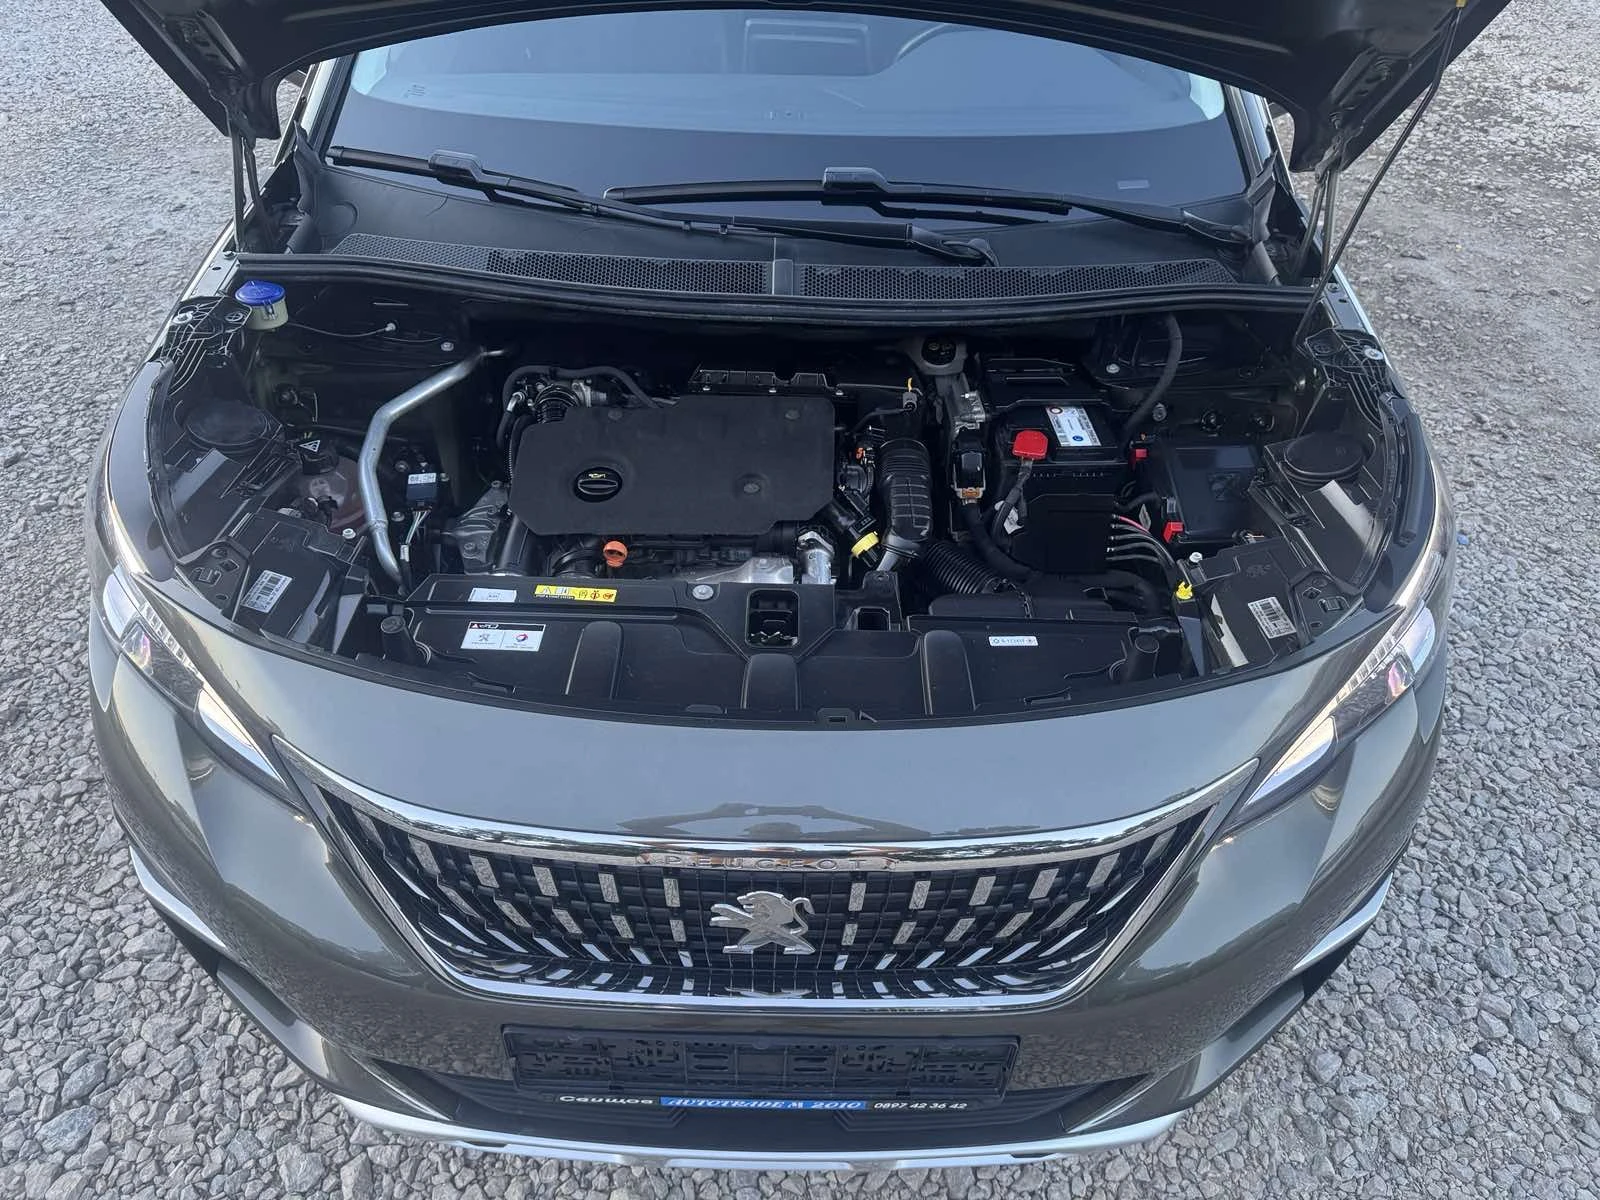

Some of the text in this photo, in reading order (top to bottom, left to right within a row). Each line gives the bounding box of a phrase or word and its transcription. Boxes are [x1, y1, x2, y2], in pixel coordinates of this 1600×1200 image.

[664, 855, 868, 870] PEUGEOT
[668, 1098, 785, 1108] AUTOTRADE
[810, 1101, 862, 1109] 2010
